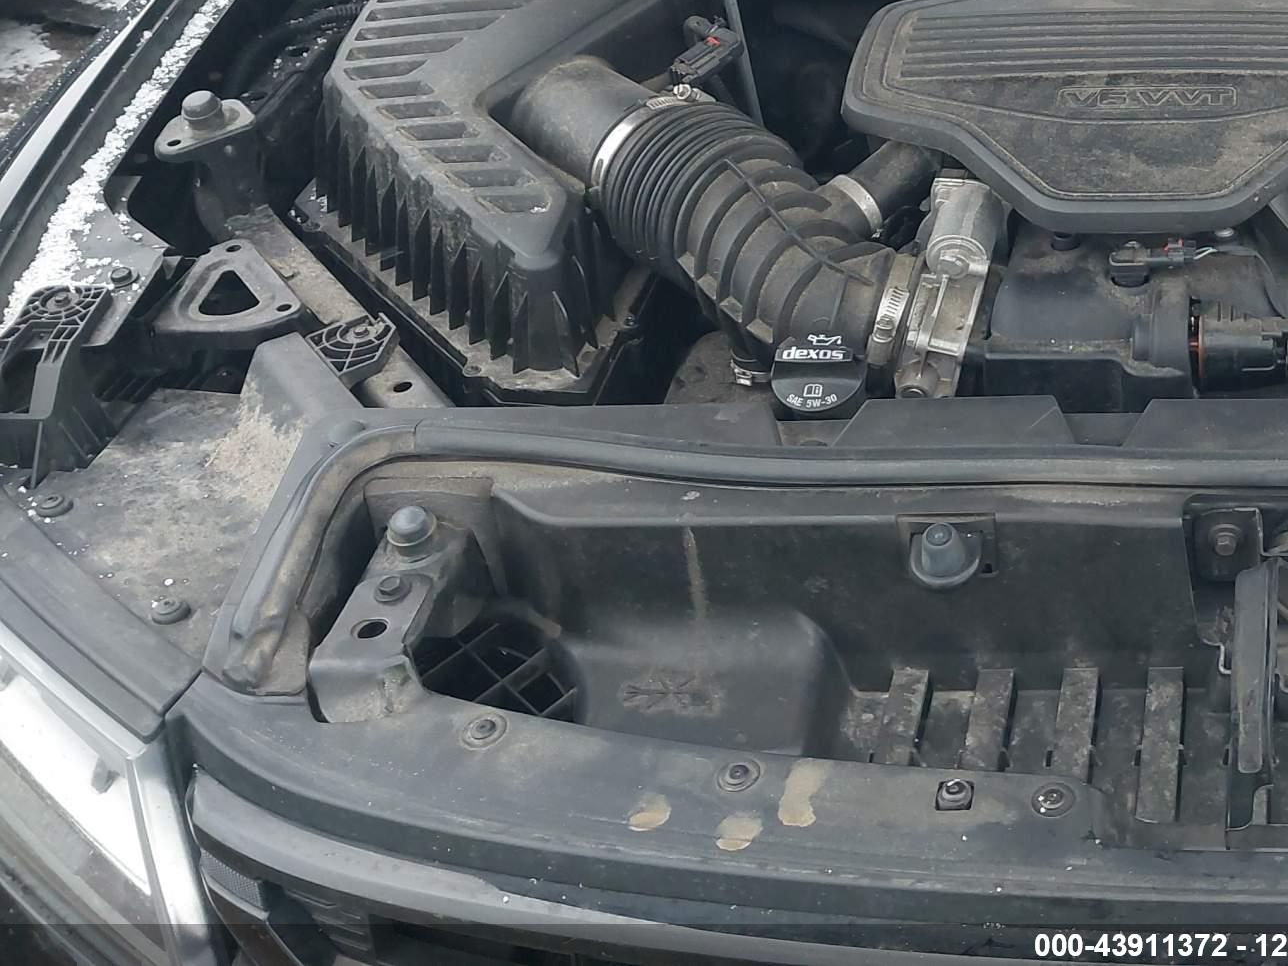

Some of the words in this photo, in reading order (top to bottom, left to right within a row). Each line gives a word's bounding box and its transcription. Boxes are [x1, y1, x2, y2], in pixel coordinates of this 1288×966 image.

[1063, 88, 1128, 108] V6
[1136, 88, 1234, 107] VVT
[782, 346, 846, 360] dexos
[786, 394, 804, 407] SAE
[805, 393, 837, 408] 5W-30
